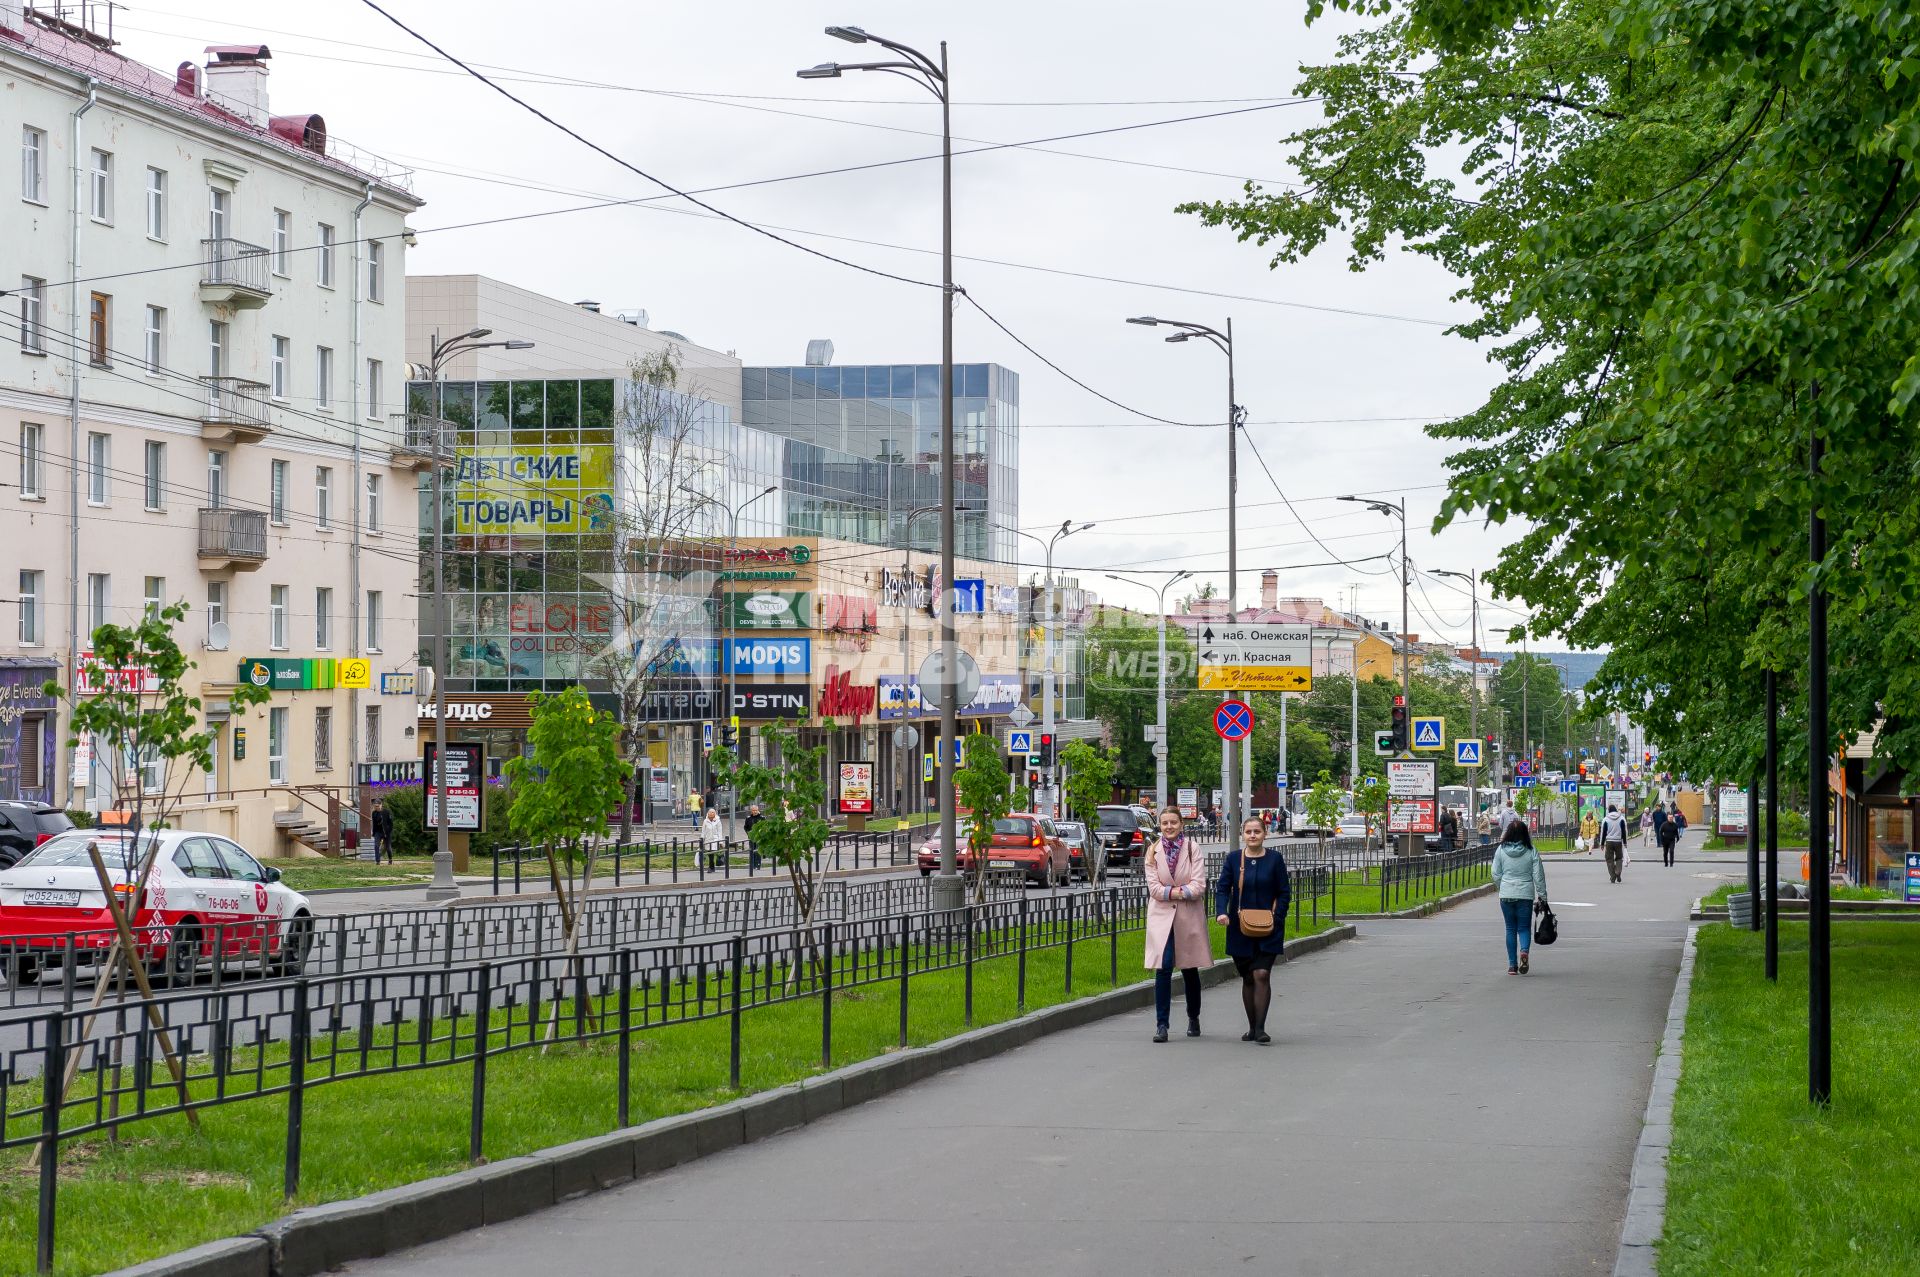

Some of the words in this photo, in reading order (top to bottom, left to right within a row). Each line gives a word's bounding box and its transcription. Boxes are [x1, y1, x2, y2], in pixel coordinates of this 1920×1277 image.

[457, 455, 579, 481] ДЕТСКИЕ
[457, 499, 571, 524] ТОВАРЫ
[510, 603, 610, 633] ELCHE
[1223, 631, 1247, 640] наб.
[1251, 631, 1308, 641] Онежская
[735, 645, 801, 664] MODIS
[1223, 653, 1240, 663] ул.
[1244, 652, 1291, 663] Красная
[13, 684, 42, 699] Events
[77, 672, 131, 692] АПЕКА
[208, 898, 239, 910] 76-06-06
